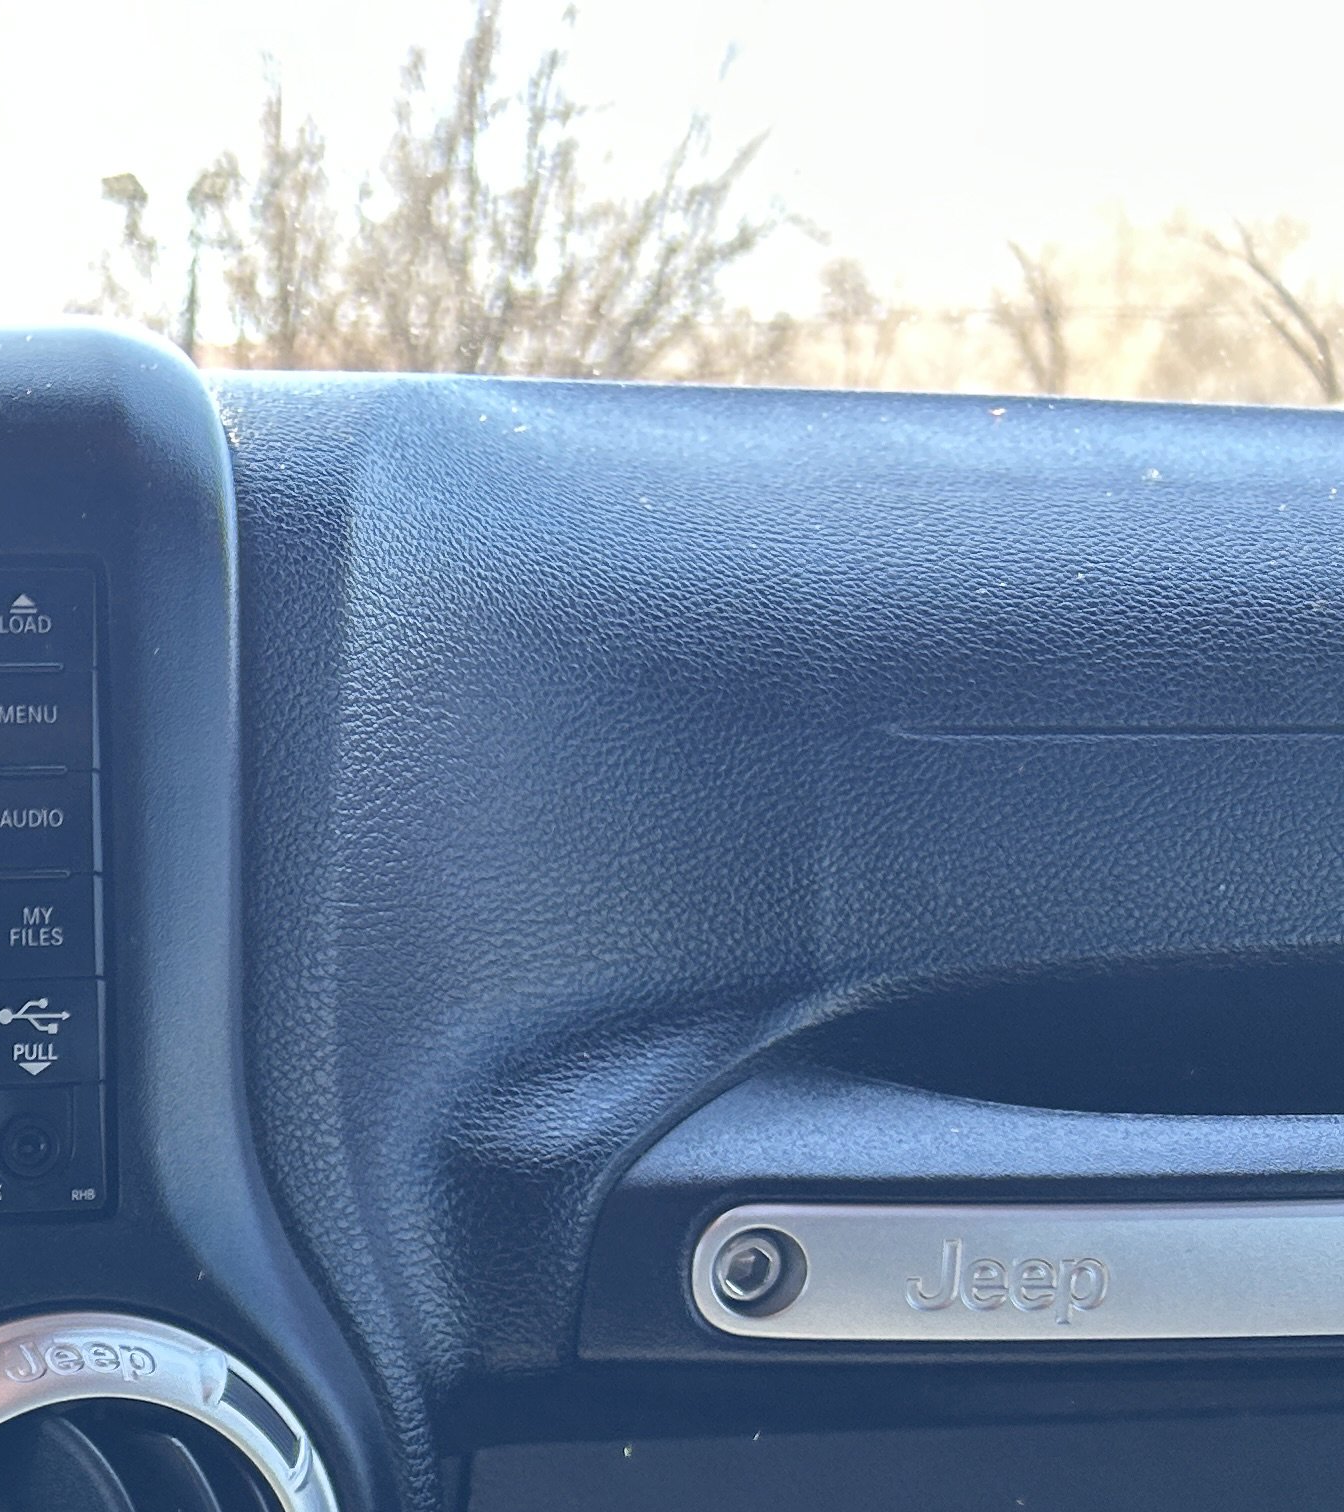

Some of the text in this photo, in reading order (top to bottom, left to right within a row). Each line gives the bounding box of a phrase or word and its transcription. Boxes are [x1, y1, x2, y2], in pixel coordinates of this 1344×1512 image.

[0, 808, 64, 828] AUDIO
[22, 906, 54, 925] MY
[10, 928, 63, 947] FILES
[13, 1043, 58, 1062] PULL
[904, 1236, 1109, 1326] Jeep
[5, 1340, 157, 1384] Jeep
